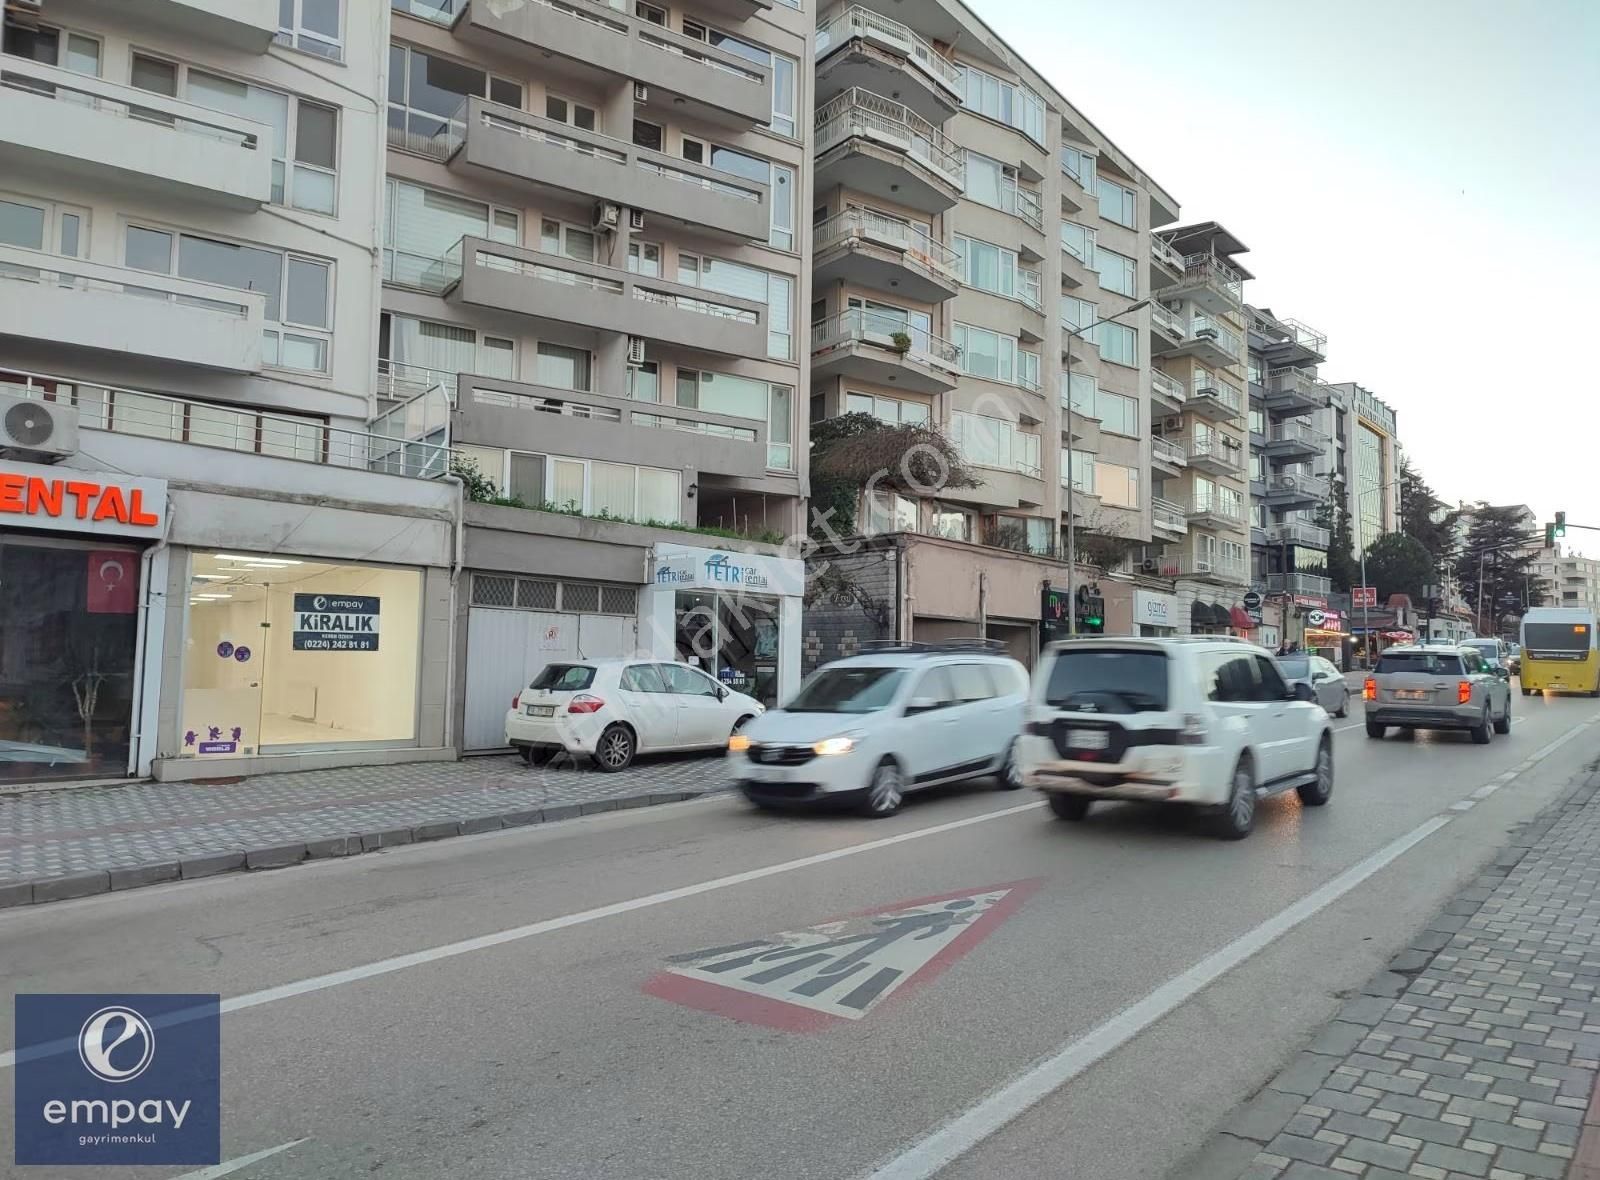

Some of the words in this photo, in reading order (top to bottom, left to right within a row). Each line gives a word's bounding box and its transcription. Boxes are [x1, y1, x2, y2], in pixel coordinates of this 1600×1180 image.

[331, 599, 364, 609] empay
[304, 640, 330, 649] (0224)
[332, 640, 347, 649] 242
